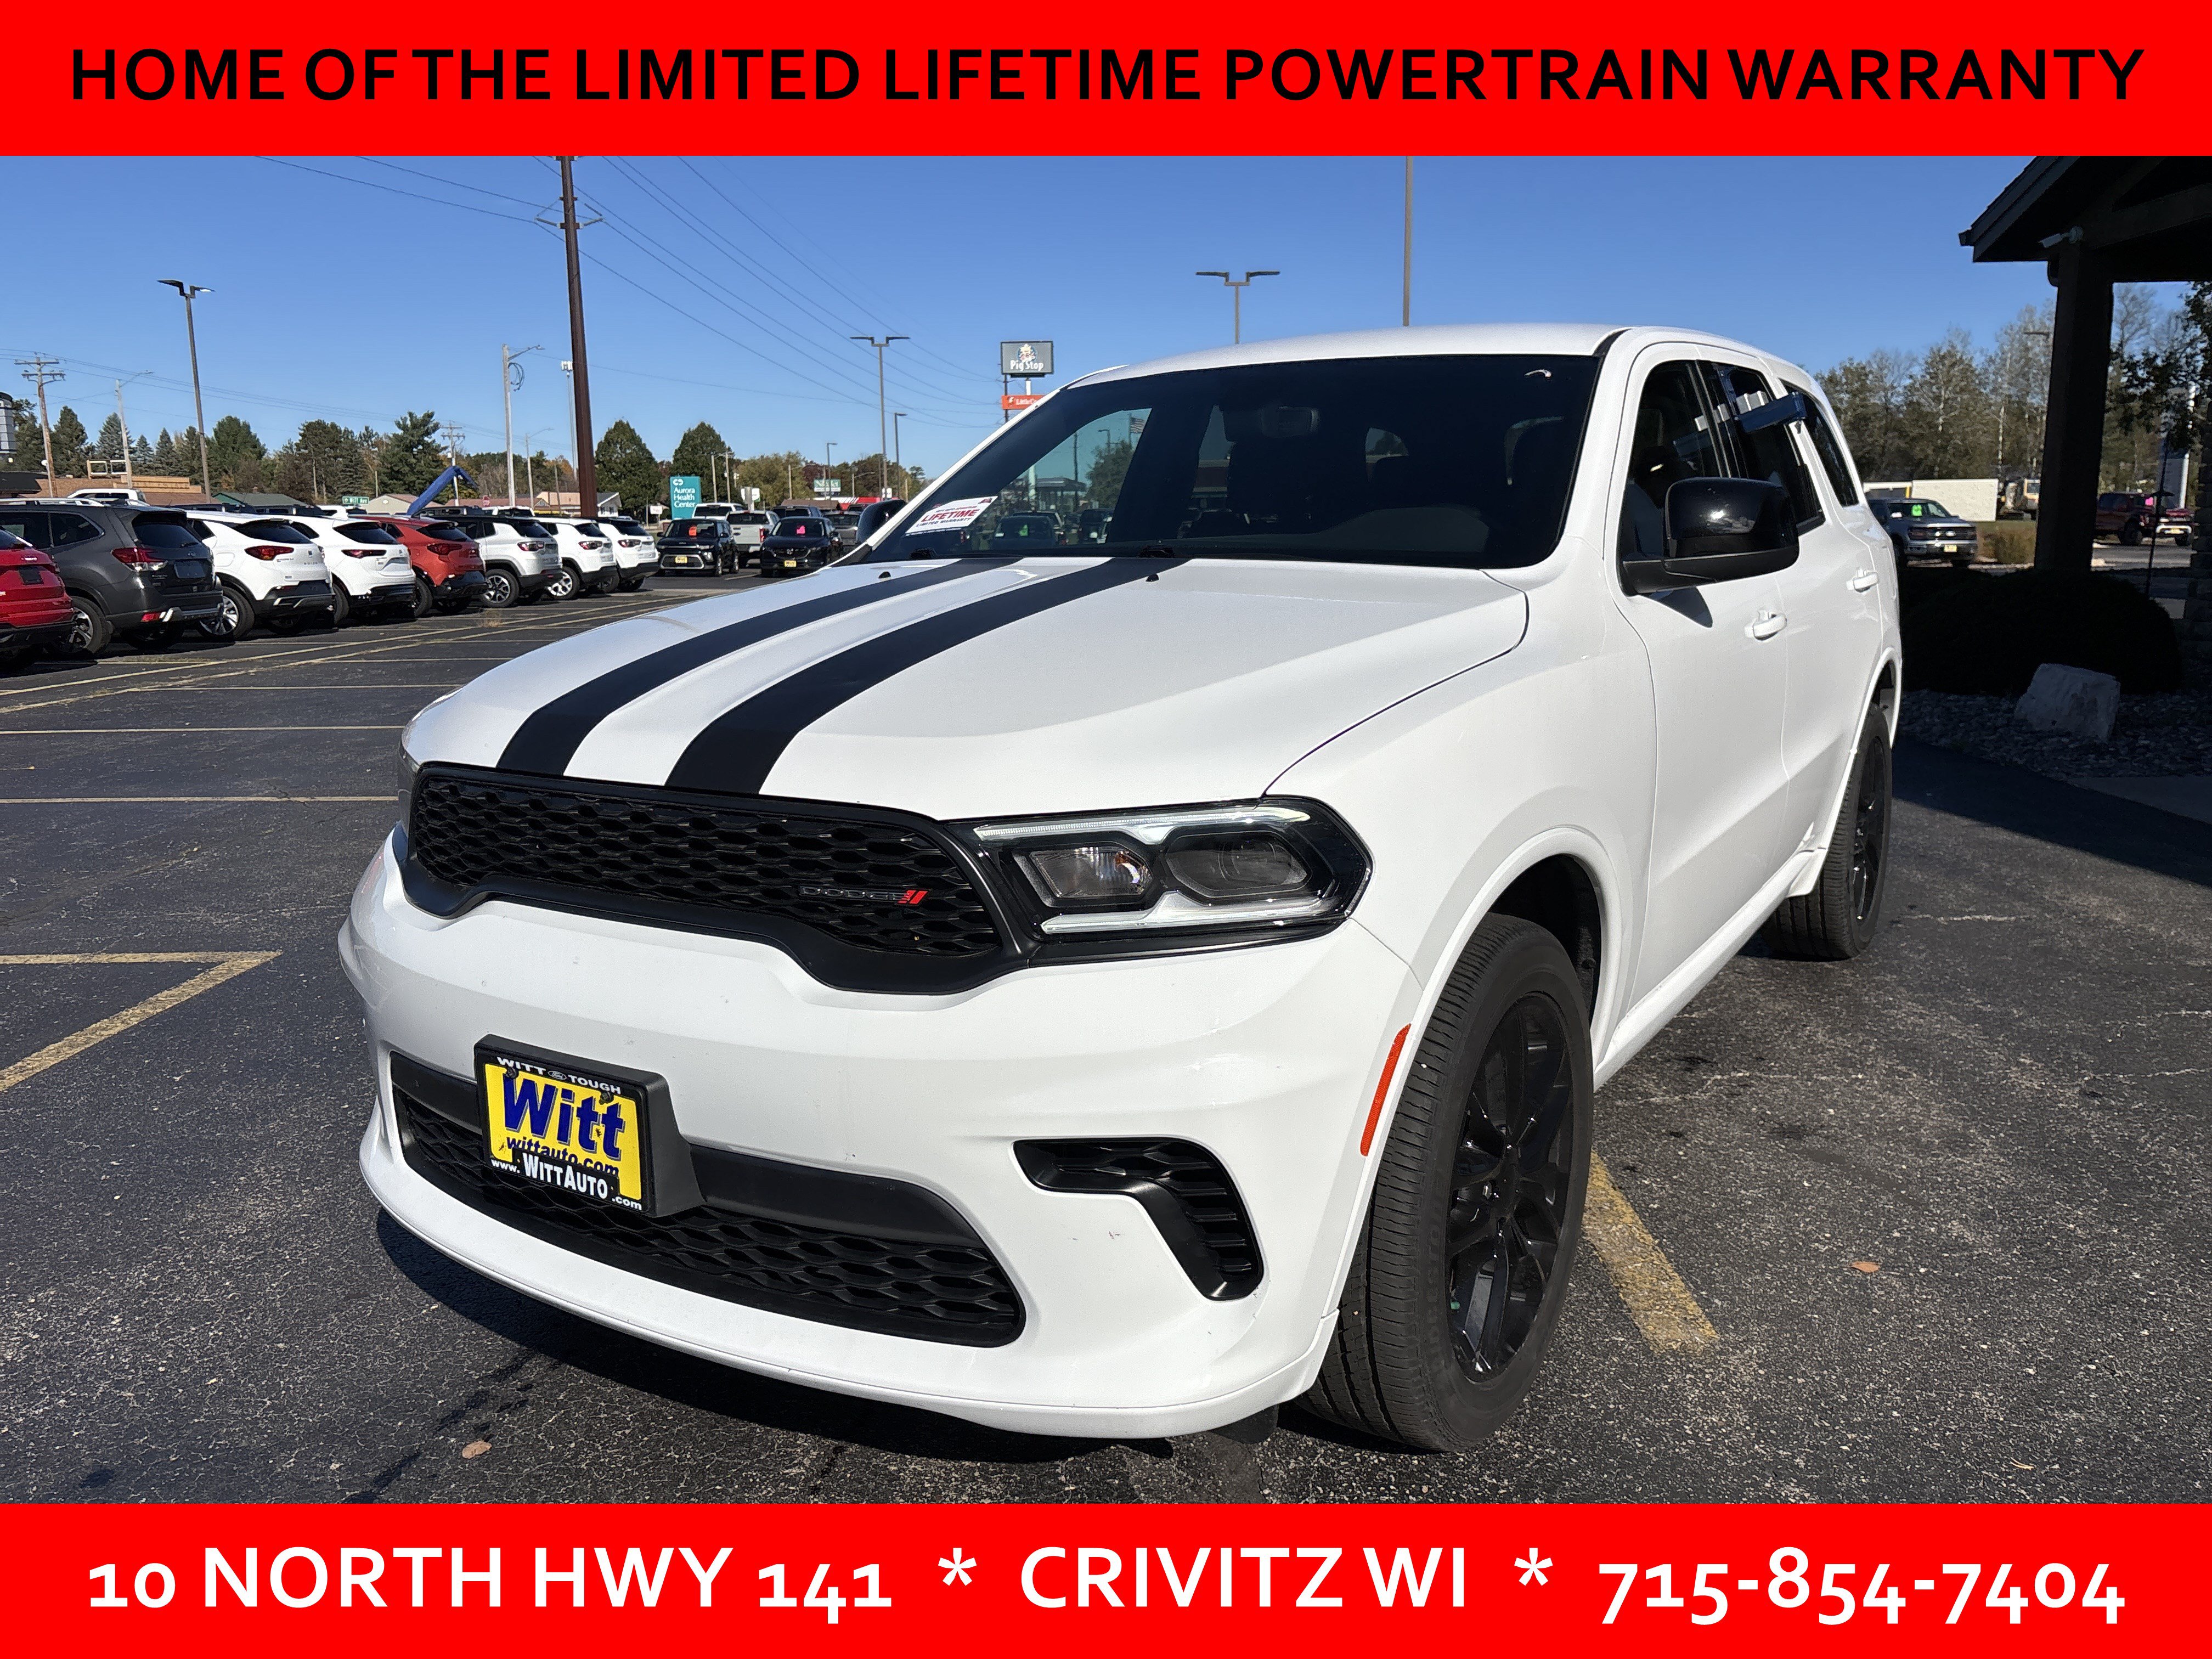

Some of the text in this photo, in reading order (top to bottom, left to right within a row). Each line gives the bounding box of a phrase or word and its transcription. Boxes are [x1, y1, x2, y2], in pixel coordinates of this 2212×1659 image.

[1010, 360, 1043, 371] Pig Stop
[921, 509, 980, 522] LIFETIME
[799, 886, 910, 901] DODGE
[496, 1057, 546, 1075] WITT
[567, 1074, 622, 1094] TOUGH
[503, 1074, 626, 1161] Witt
[506, 1137, 619, 1177] wittauto.com
[491, 1159, 520, 1173] www.
[612, 1195, 642, 1211] .com
